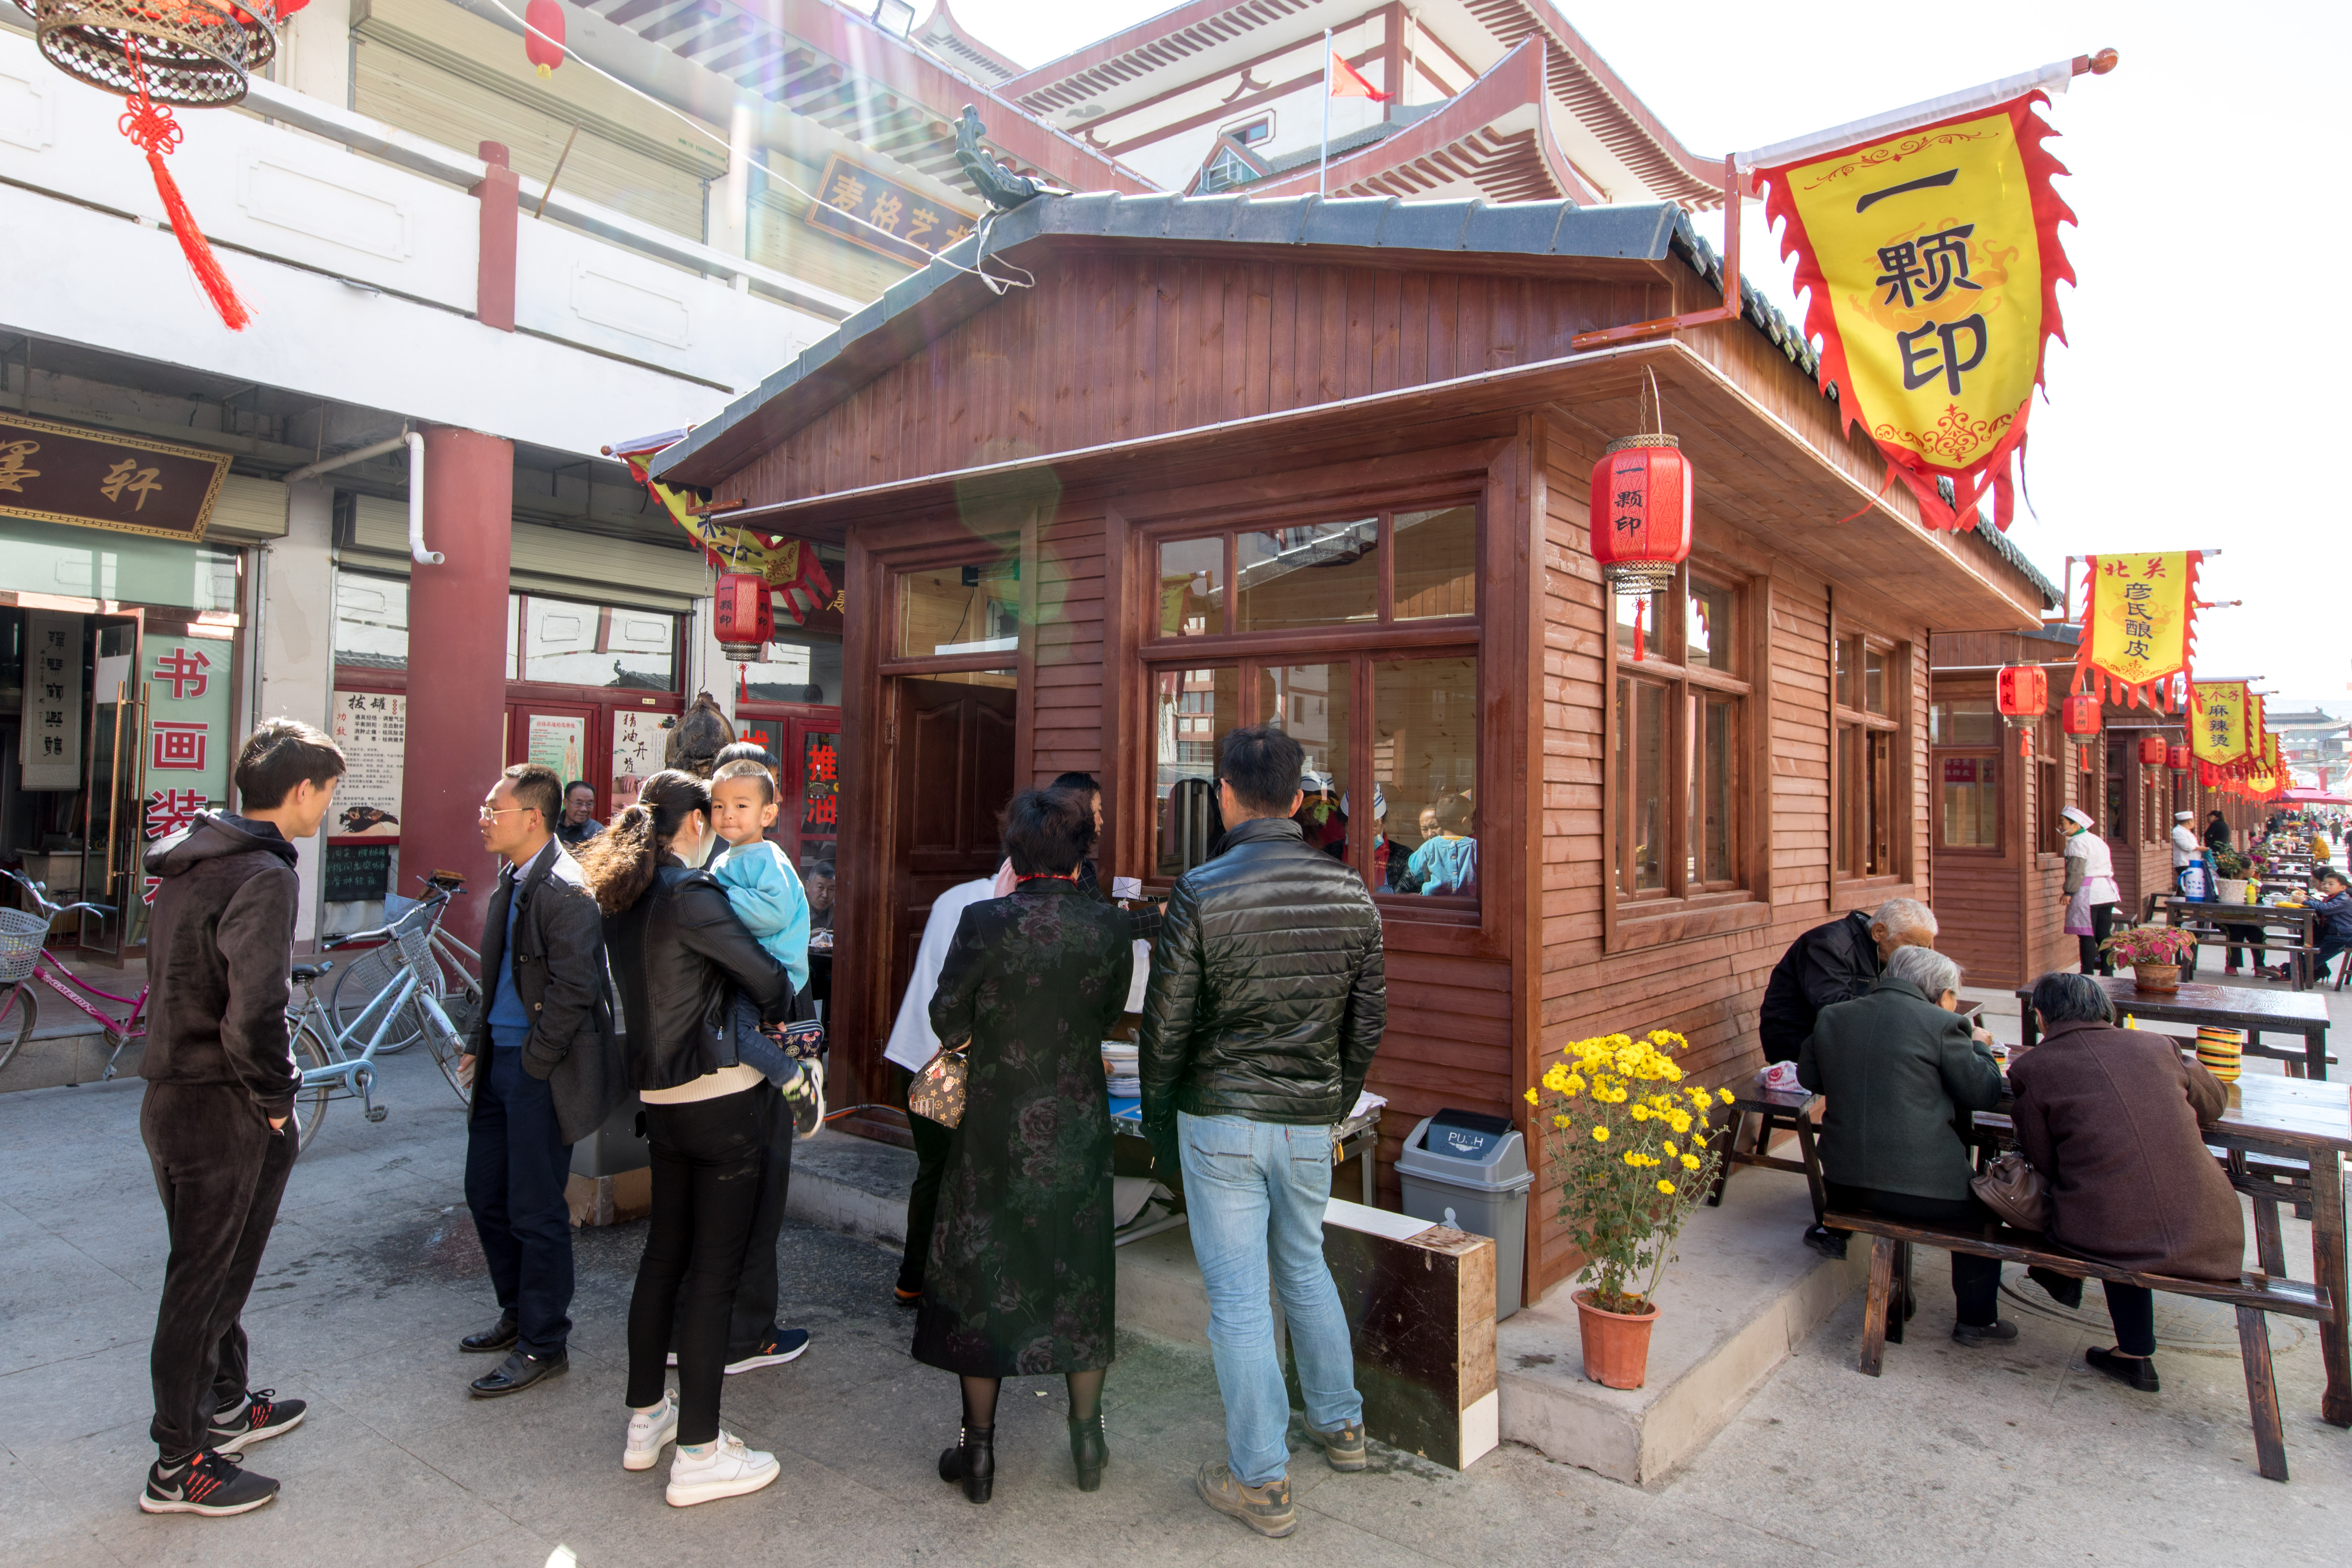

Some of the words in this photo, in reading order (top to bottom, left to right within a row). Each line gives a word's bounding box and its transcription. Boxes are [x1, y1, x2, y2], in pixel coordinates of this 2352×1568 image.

[828, 174, 969, 252] 麦格艺术
[1856, 168, 1989, 396] 一颗印
[1614, 467, 1644, 538] 一颗印
[2103, 557, 2166, 579] 北关
[719, 586, 734, 628] 一颗印
[758, 588, 769, 630] 一颗印
[2123, 582, 2153, 661] 彦氏酿皮
[336, 713, 347, 736] 功效
[348, 694, 386, 713] 拔罐
[2208, 705, 2229, 747] 麻辣烫
[622, 713, 648, 772] 精油开背
[145, 647, 211, 908] 书画装
[808, 744, 837, 824] 推油
[1448, 1132, 1484, 1147] PUH
